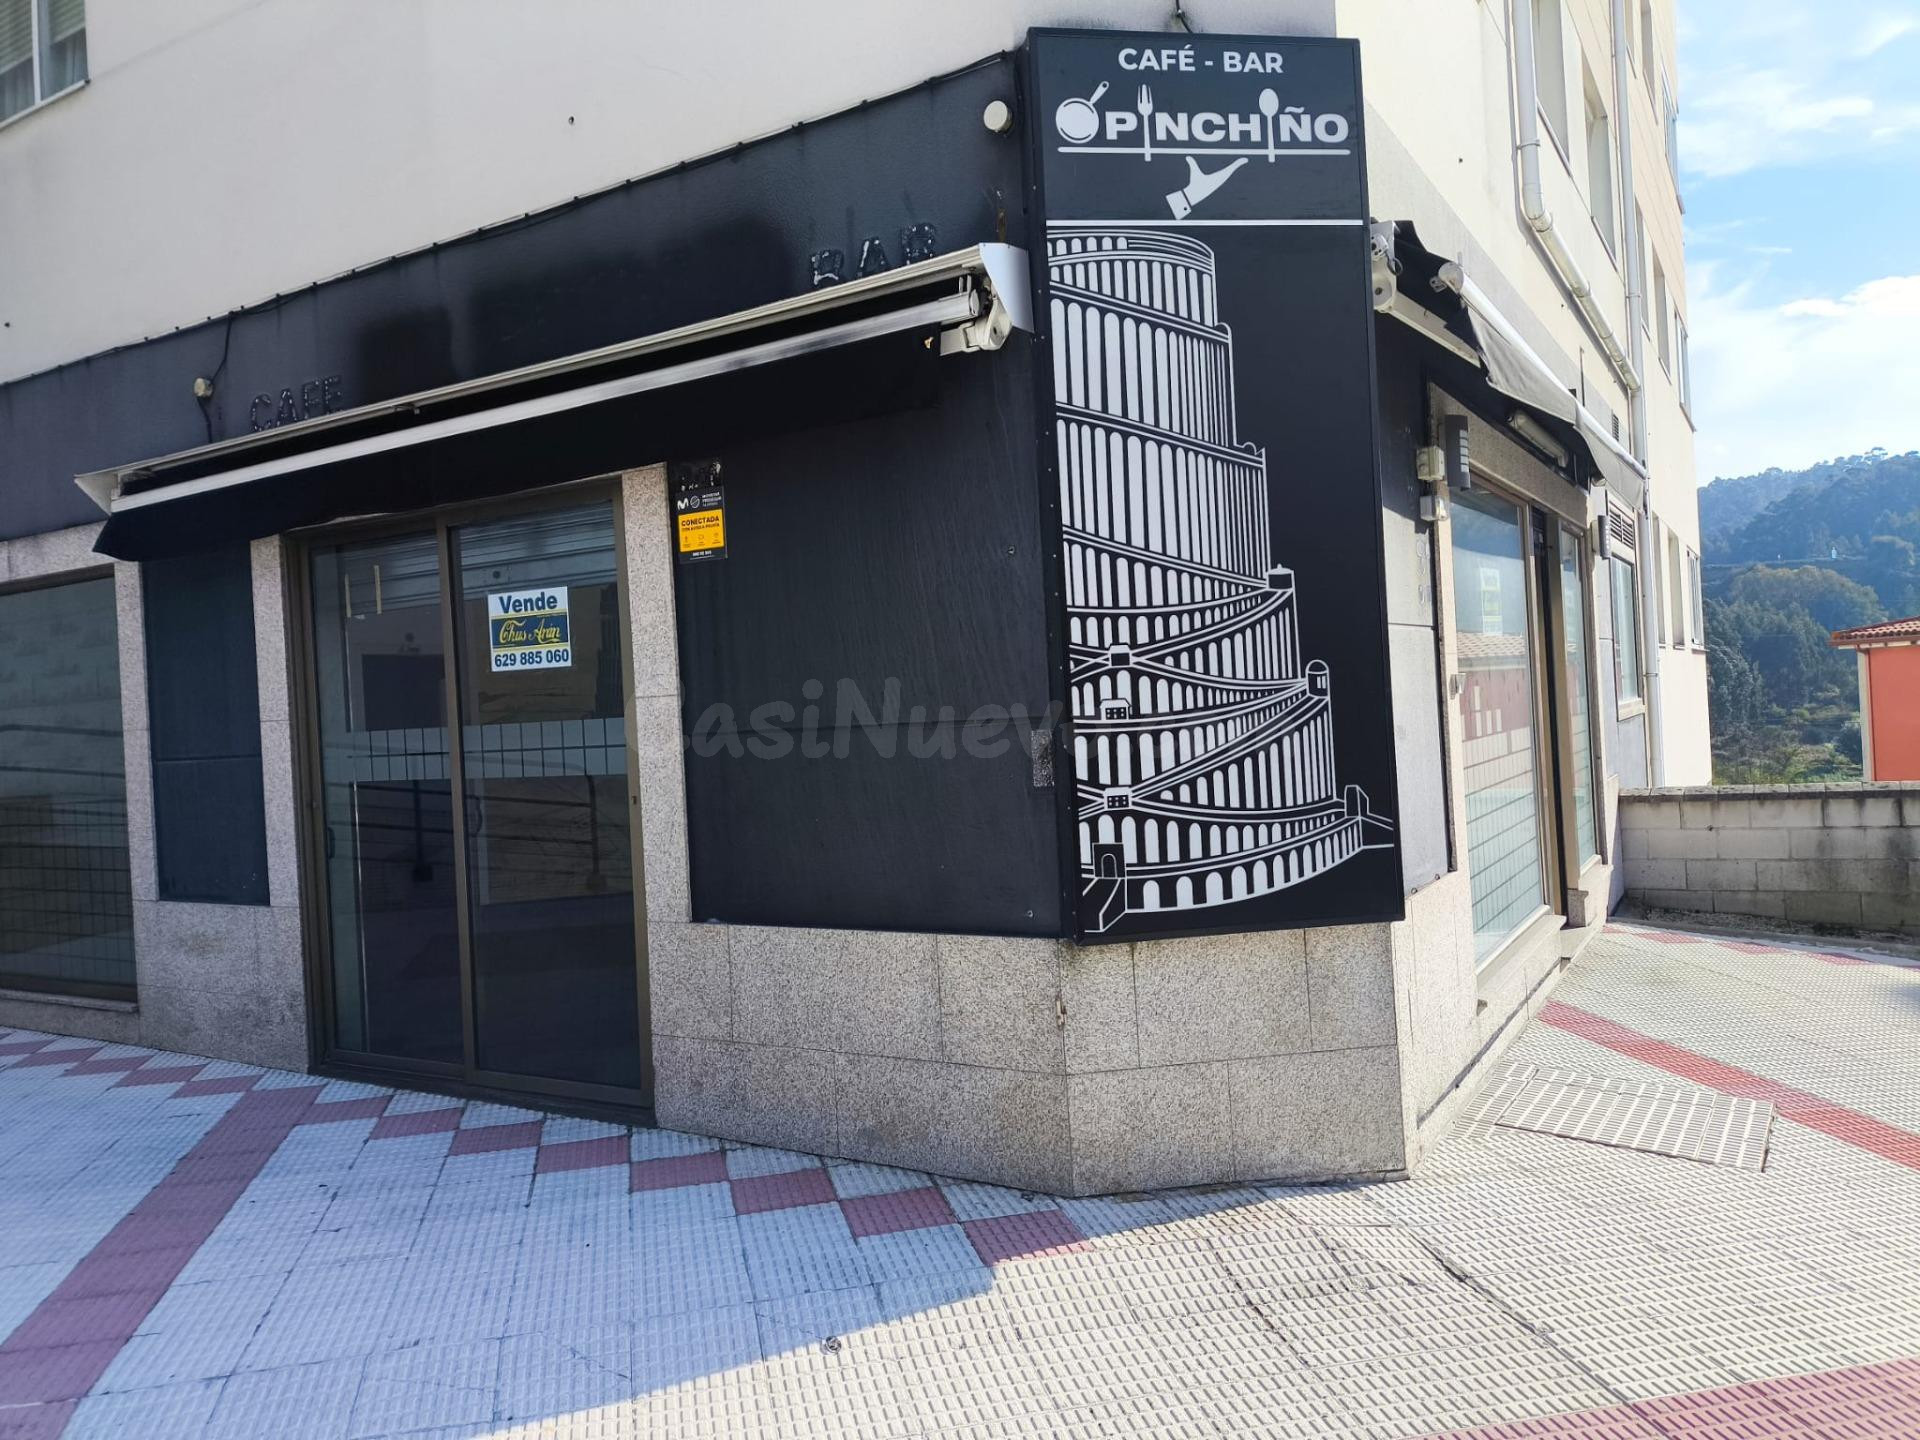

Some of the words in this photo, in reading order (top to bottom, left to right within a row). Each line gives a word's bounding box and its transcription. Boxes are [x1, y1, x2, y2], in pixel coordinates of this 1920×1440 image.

[1118, 44, 1195, 71] CAFÉ
[1223, 51, 1283, 73] BAR
[499, 592, 558, 614] Vende
[495, 653, 516, 667] 629
[520, 651, 542, 665] 885
[546, 648, 569, 663] 060
